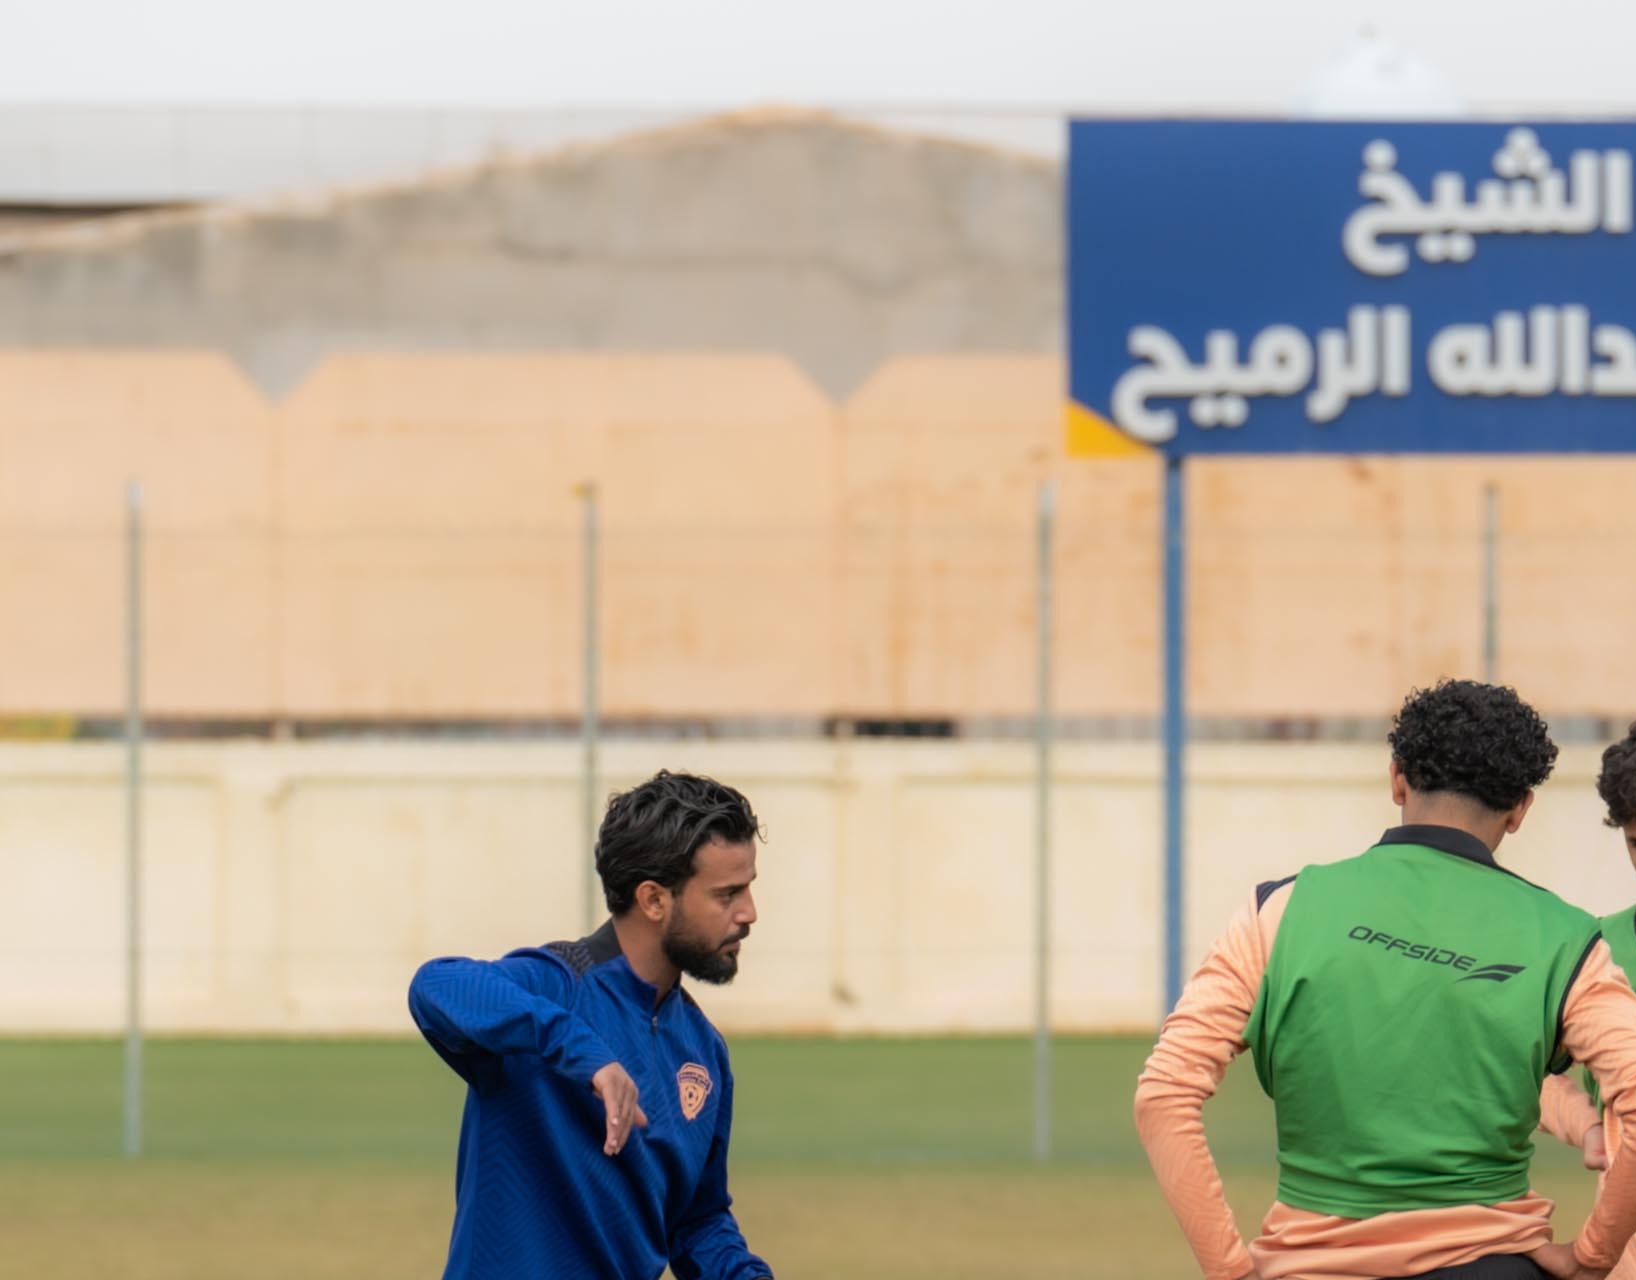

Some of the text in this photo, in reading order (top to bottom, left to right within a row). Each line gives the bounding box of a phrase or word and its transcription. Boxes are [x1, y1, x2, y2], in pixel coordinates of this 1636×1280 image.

[1341, 126, 1634, 277] الشيخ
[1111, 304, 1411, 443] الرميح
[1348, 925, 1477, 972] OFFSIDE
